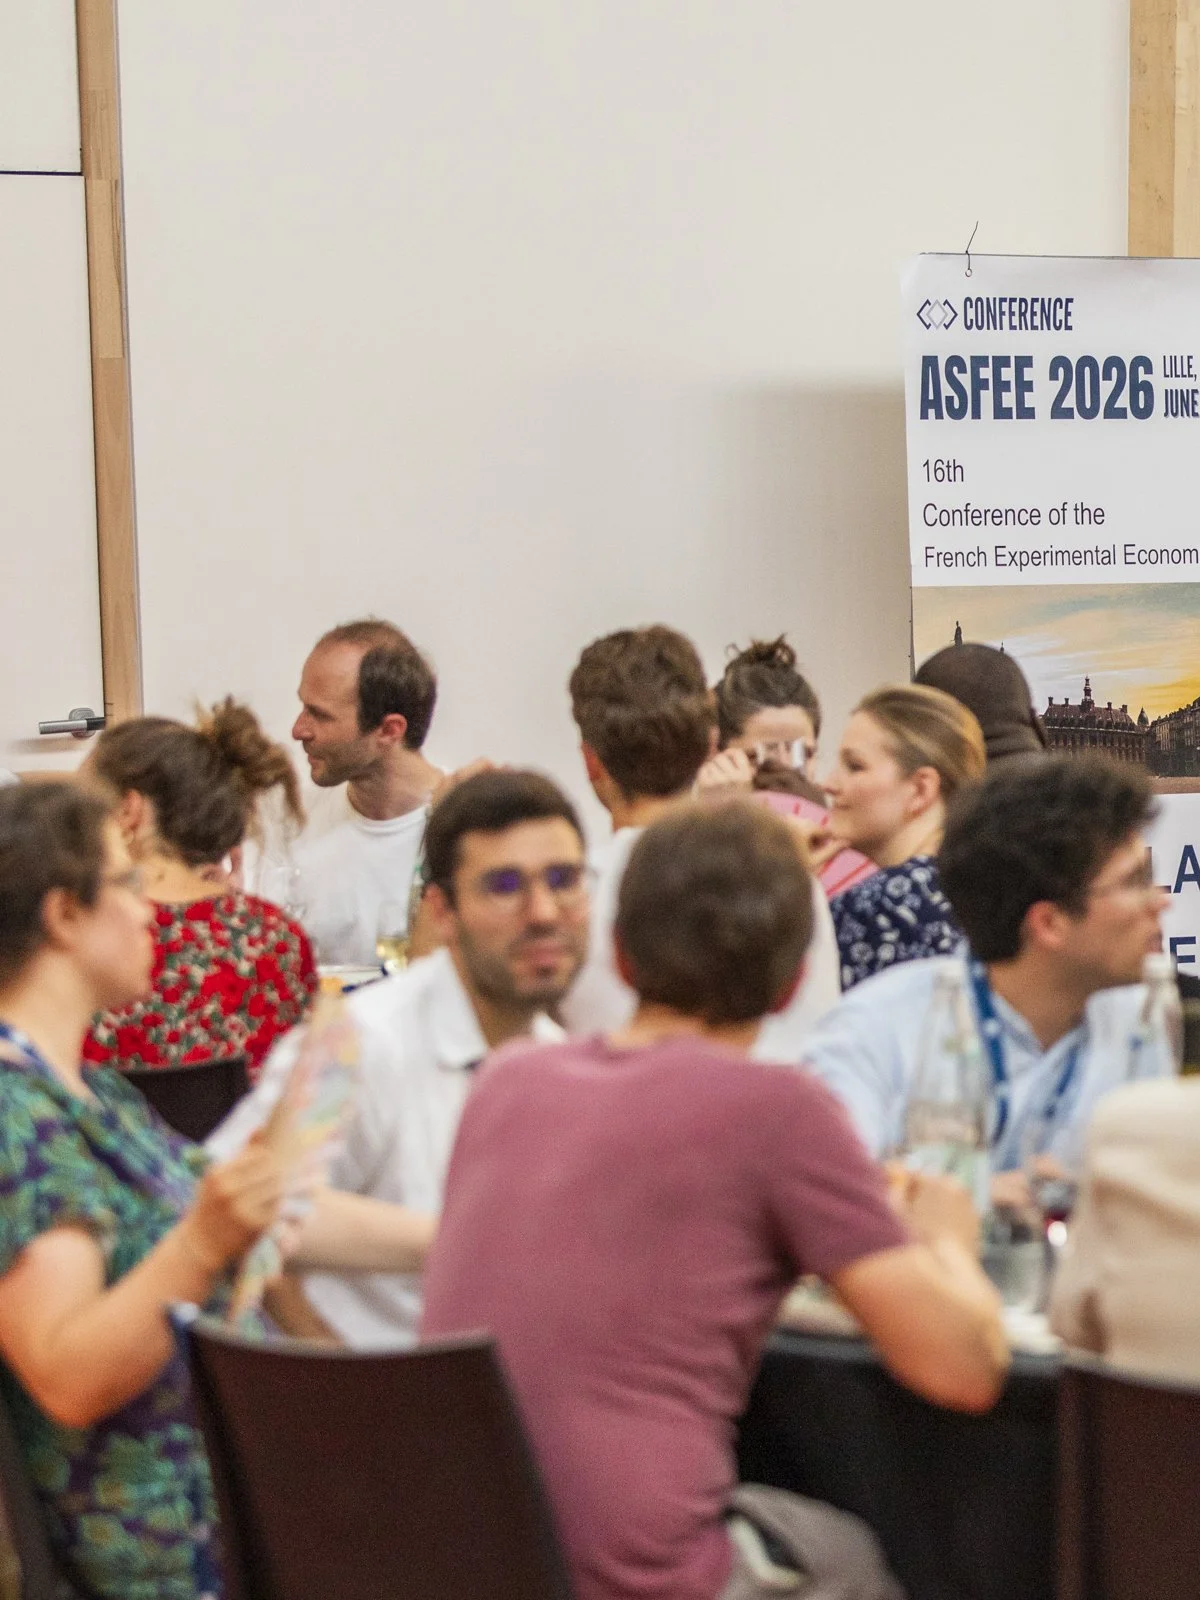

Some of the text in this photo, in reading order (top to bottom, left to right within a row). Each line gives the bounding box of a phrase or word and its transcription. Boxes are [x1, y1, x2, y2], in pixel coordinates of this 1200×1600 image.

[963, 296, 1075, 332] CONFERENCE
[1162, 354, 1197, 382] LILLE,
[919, 354, 1155, 421] ASFEE 2026
[1163, 388, 1200, 419] JUNE
[922, 458, 964, 483] 16th
[923, 501, 1105, 527] Conference of the
[924, 545, 987, 568] French
[994, 544, 1116, 572] Experimental
